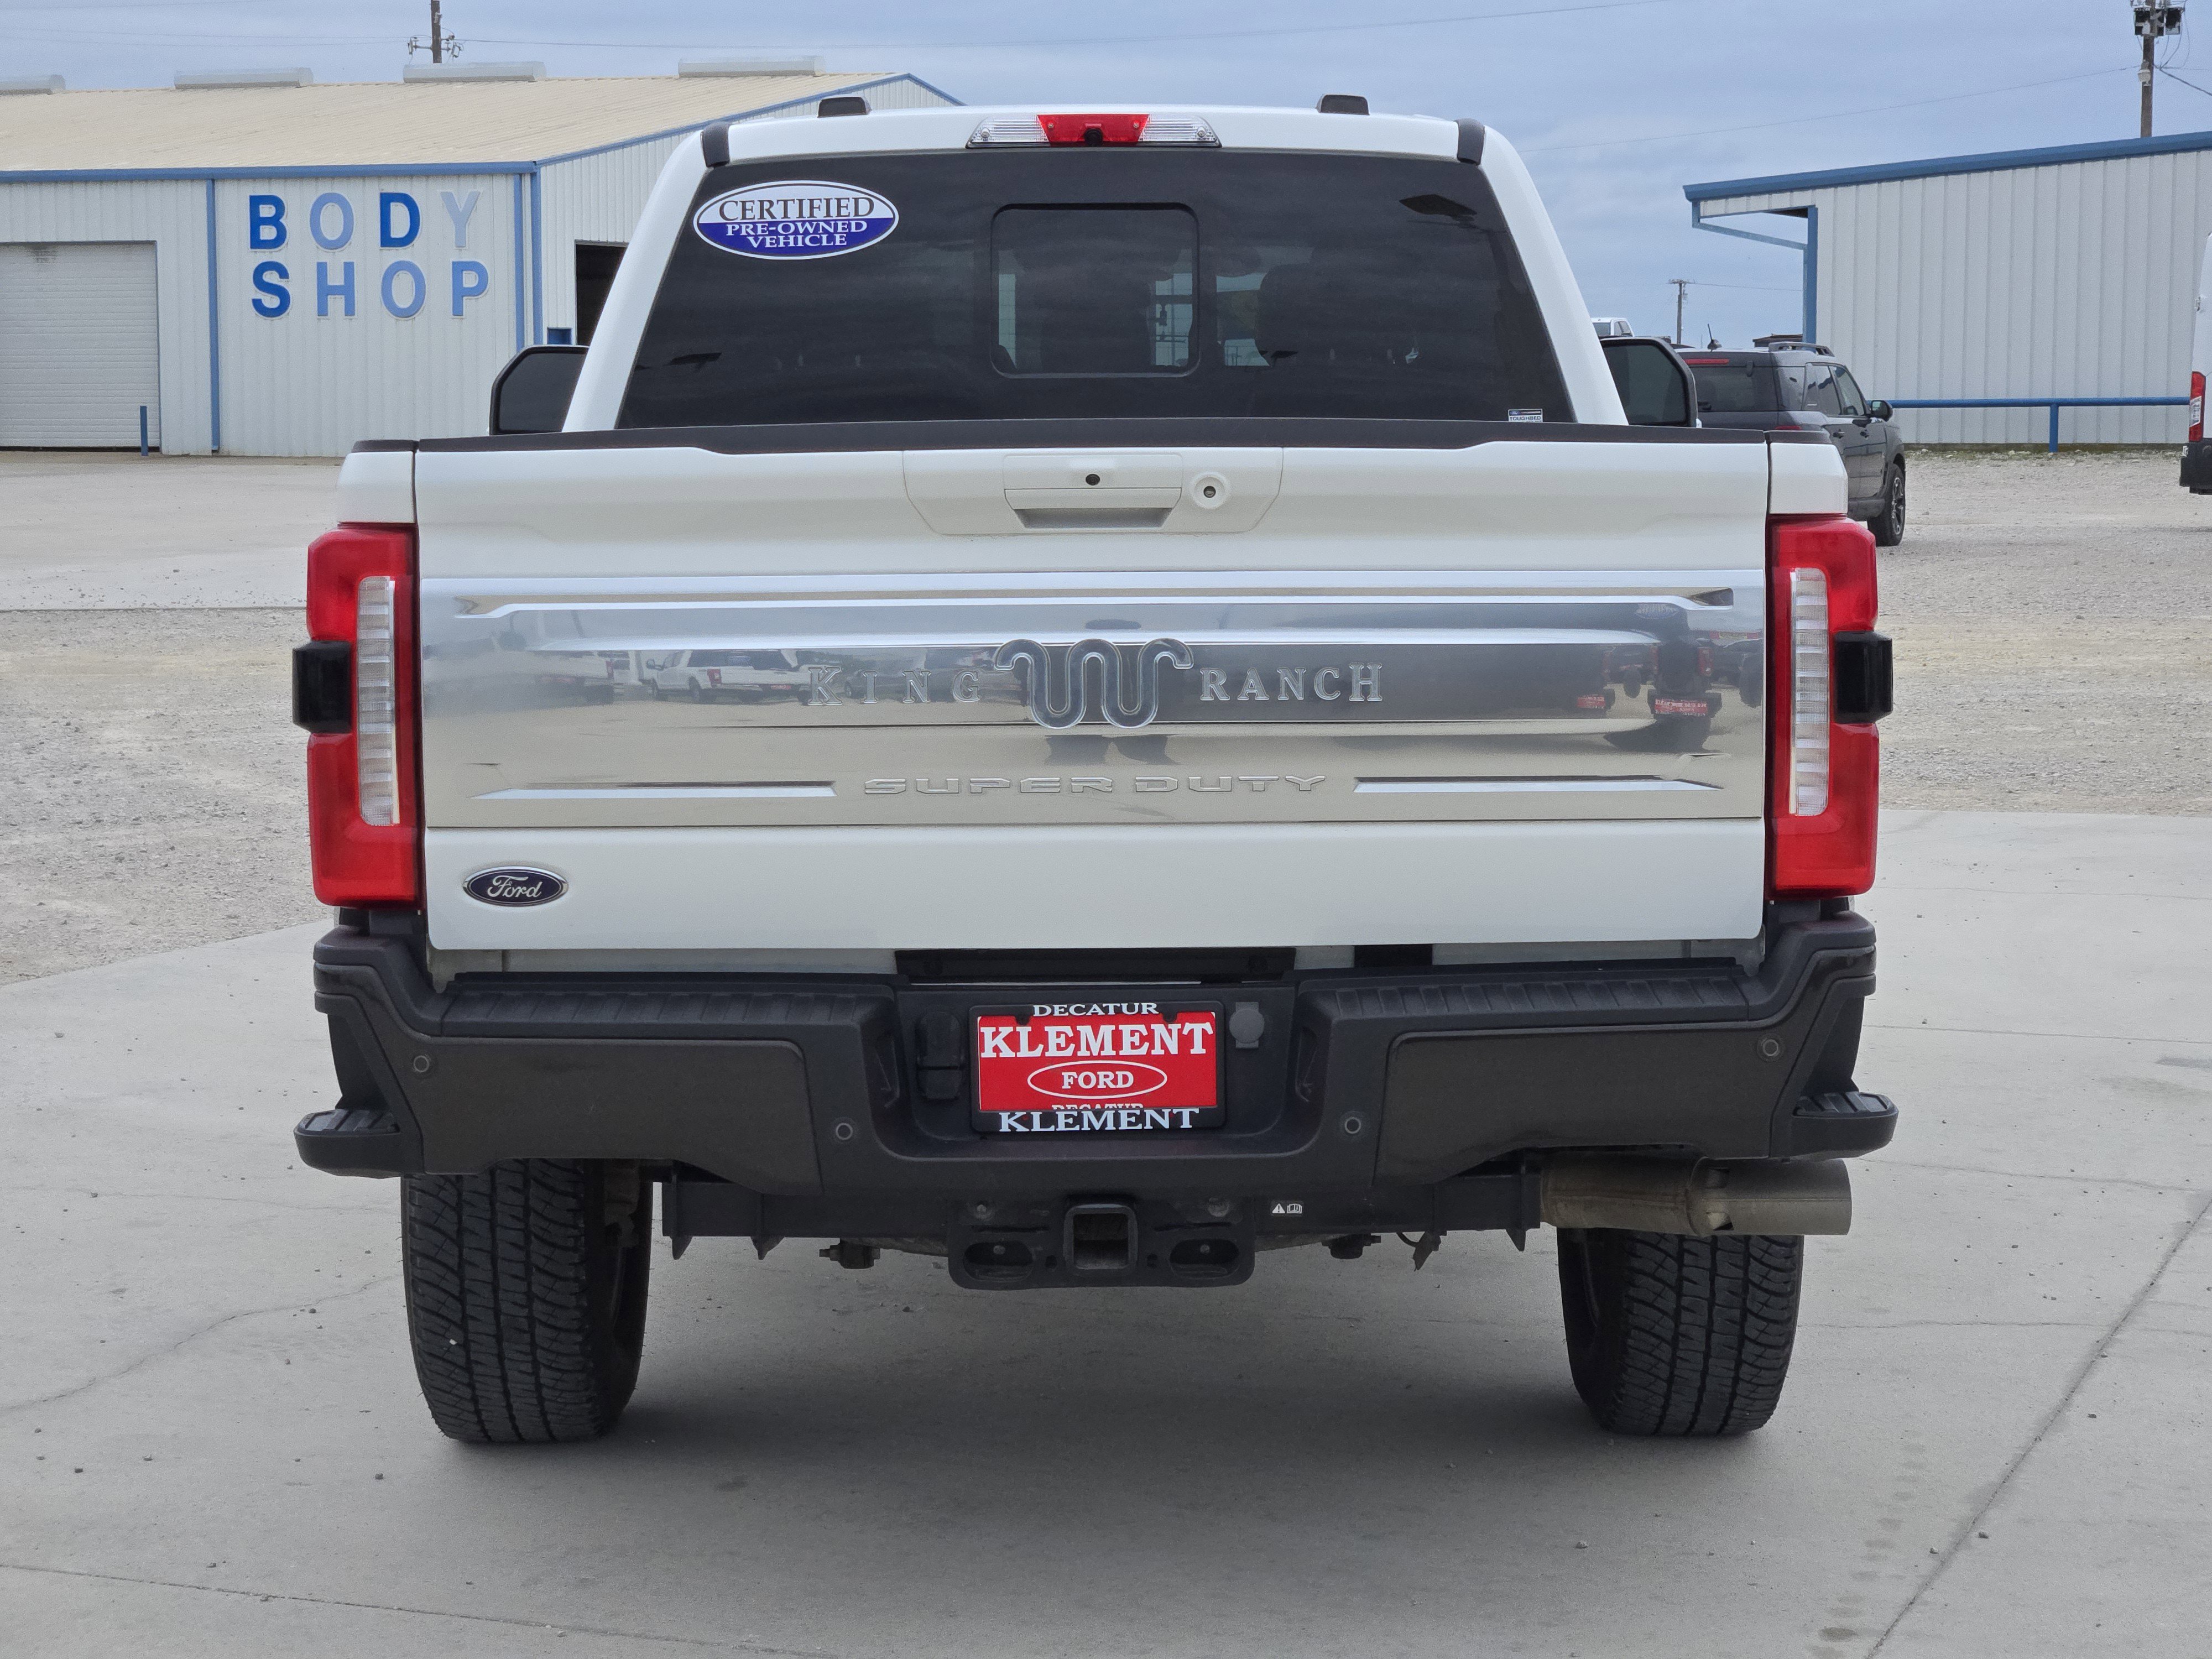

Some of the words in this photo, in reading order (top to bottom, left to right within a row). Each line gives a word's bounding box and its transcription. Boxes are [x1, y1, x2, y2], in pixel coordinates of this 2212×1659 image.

[249, 191, 481, 249] BODY
[719, 197, 874, 221] CERTIFIED
[726, 221, 867, 236] PRE-OWNED
[747, 234, 847, 248] VEHICLE
[252, 260, 489, 318] SHOP
[807, 665, 981, 706] KING
[1200, 663, 1383, 702] RANCH
[865, 777, 1113, 794] SUPER
[1135, 775, 1326, 793] DUTY
[487, 875, 542, 898] Ford
[1032, 1002, 1159, 1017] DECATUR
[980, 1022, 1214, 1058] KLEMENT
[1061, 1071, 1134, 1089] FORD
[999, 1108, 1200, 1133] KLEMENT
